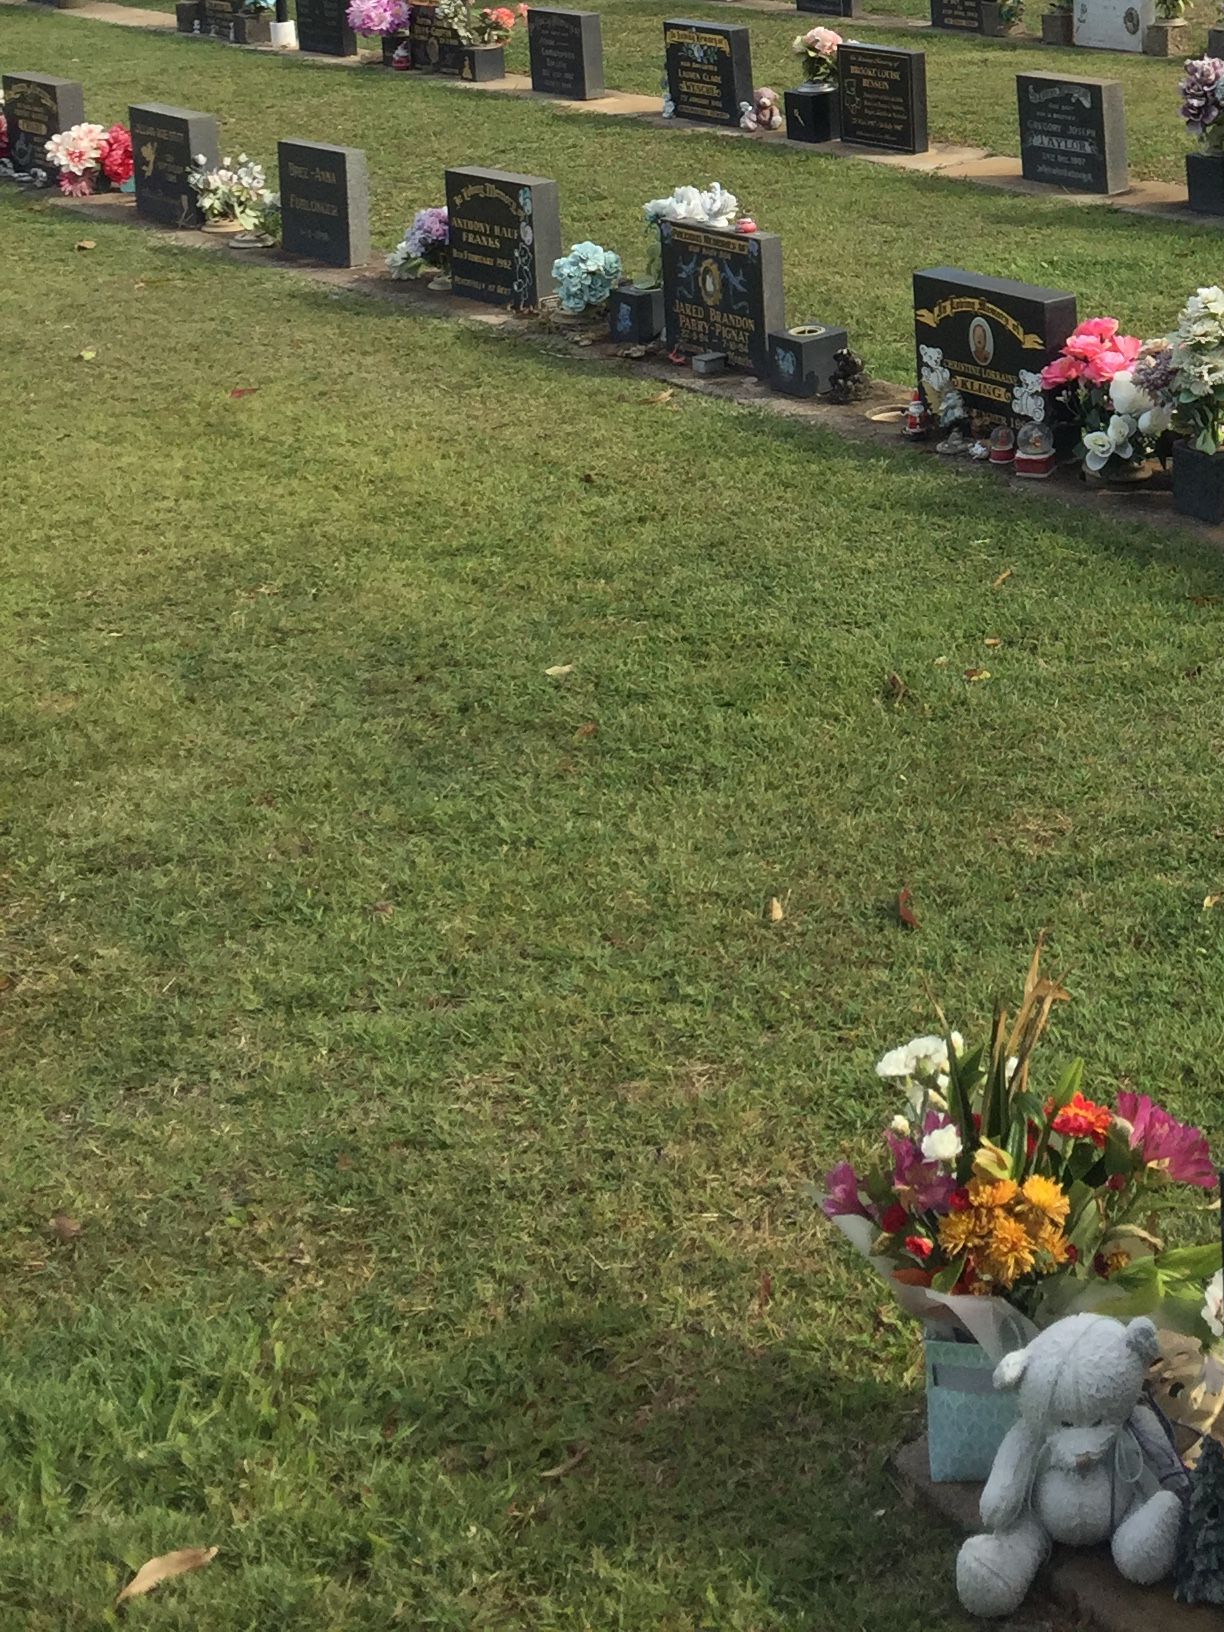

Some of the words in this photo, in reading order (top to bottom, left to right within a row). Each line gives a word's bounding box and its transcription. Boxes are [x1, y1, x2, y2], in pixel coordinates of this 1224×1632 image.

[672, 299, 705, 319] JARED
[708, 307, 755, 332] BRANDON
[960, 379, 1002, 399] KLING
